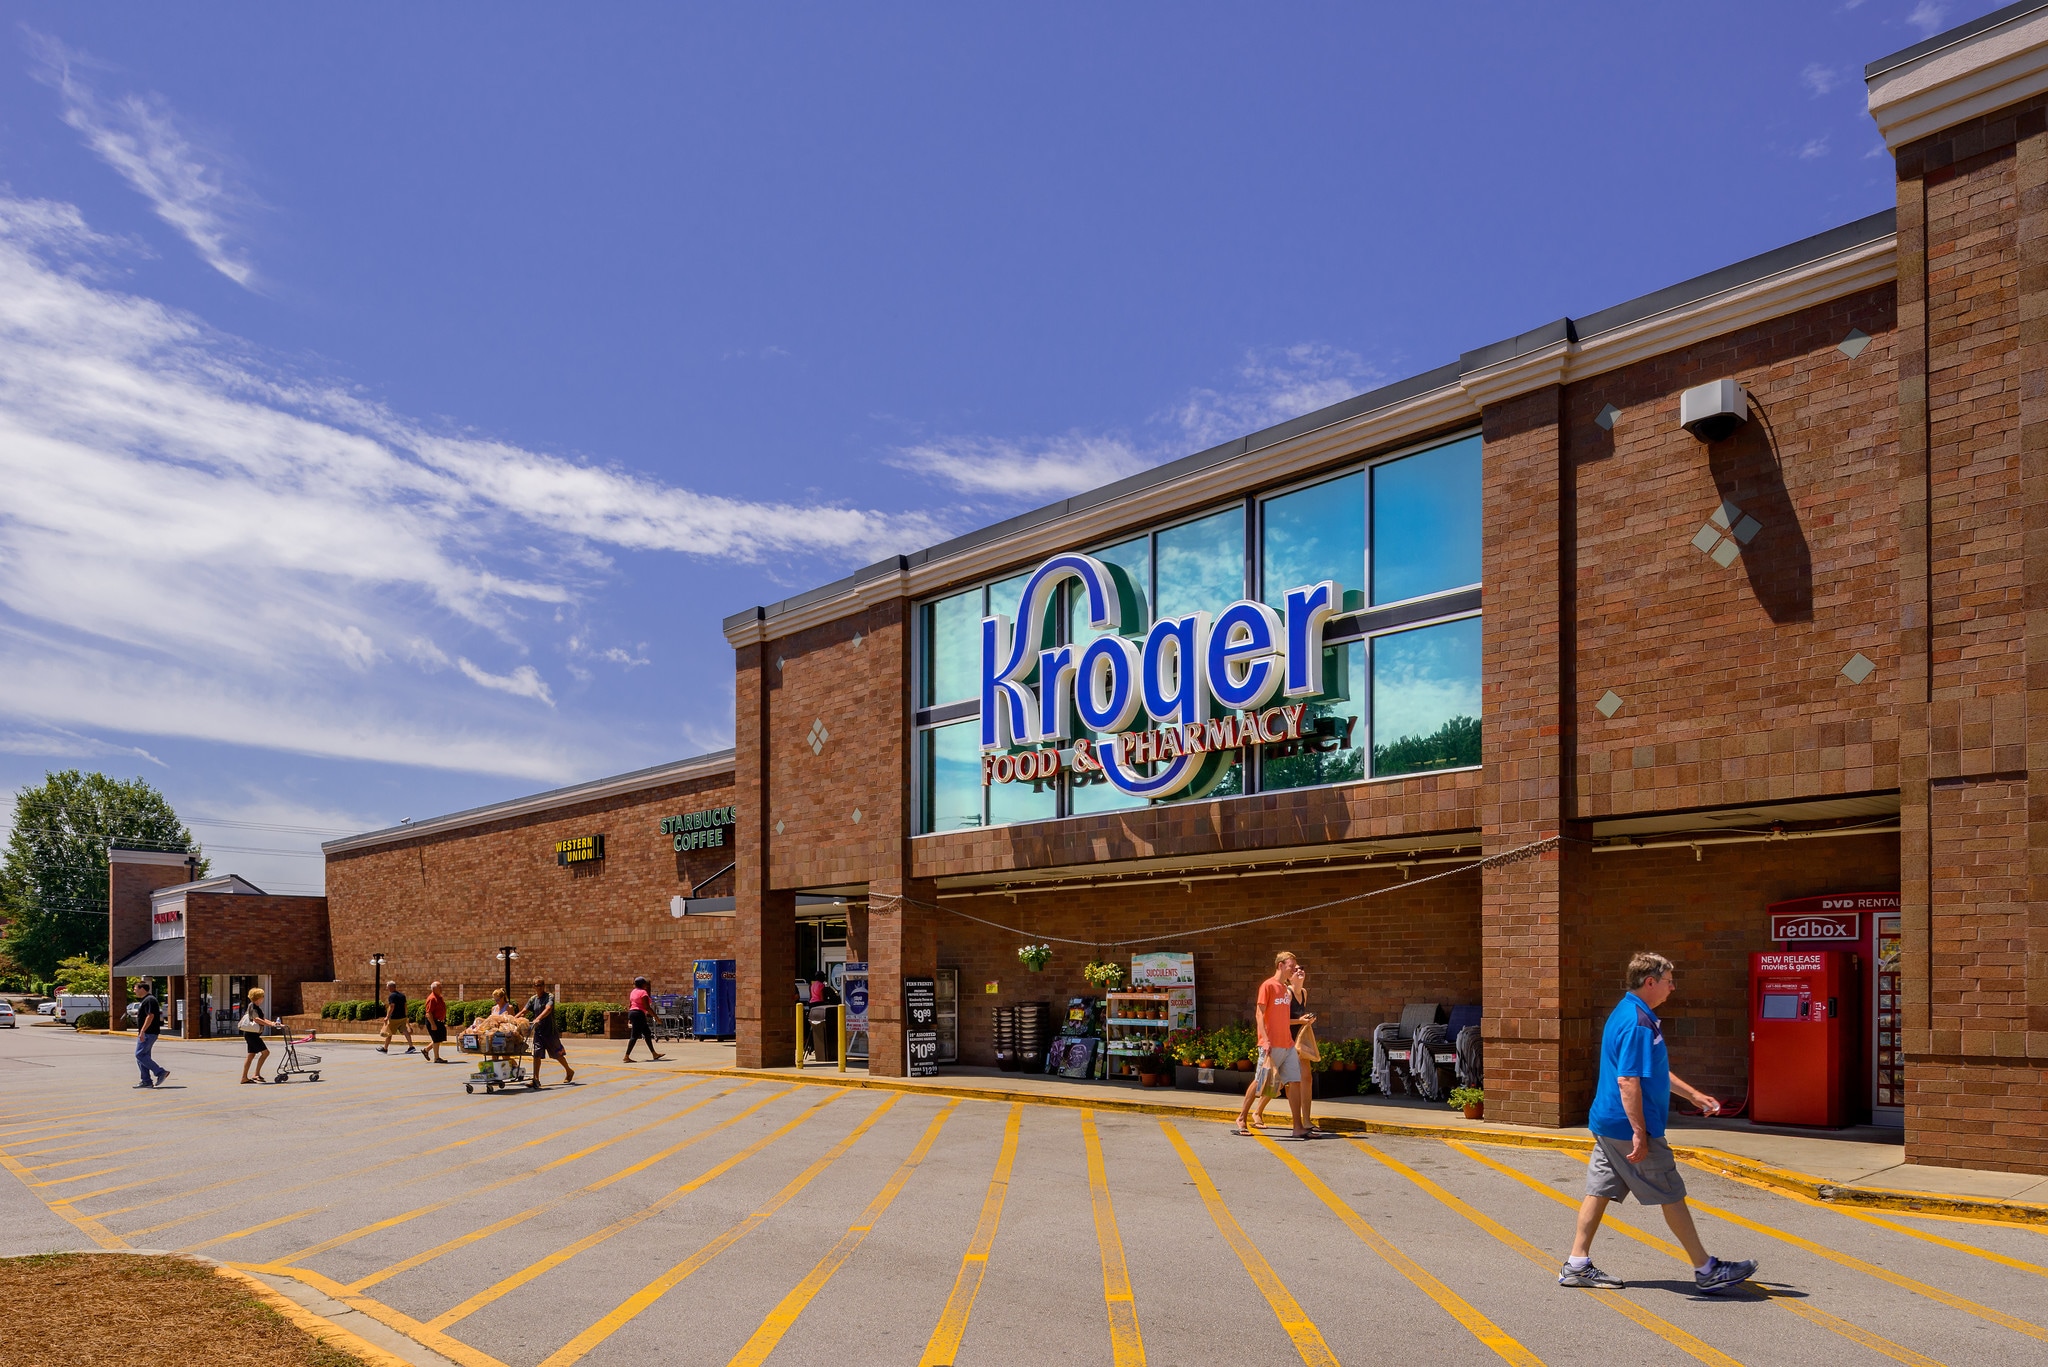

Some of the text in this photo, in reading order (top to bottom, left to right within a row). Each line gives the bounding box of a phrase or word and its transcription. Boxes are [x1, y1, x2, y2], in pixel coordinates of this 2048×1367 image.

[980, 552, 1343, 799] Kroger
[980, 703, 1307, 786] FOOD & PHARMACY
[660, 805, 737, 835] STARBUCKS
[555, 836, 593, 852] WESTERN
[673, 828, 723, 852] COFFEE
[566, 848, 593, 862] UNION
[1822, 900, 1854, 909] DVD
[1779, 921, 1848, 937] redbox
[1783, 955, 1821, 963] RELEASE
[1146, 968, 1178, 977] SUCCULENTS
[1796, 964, 1821, 972] games
[721, 972, 736, 980] Glac
